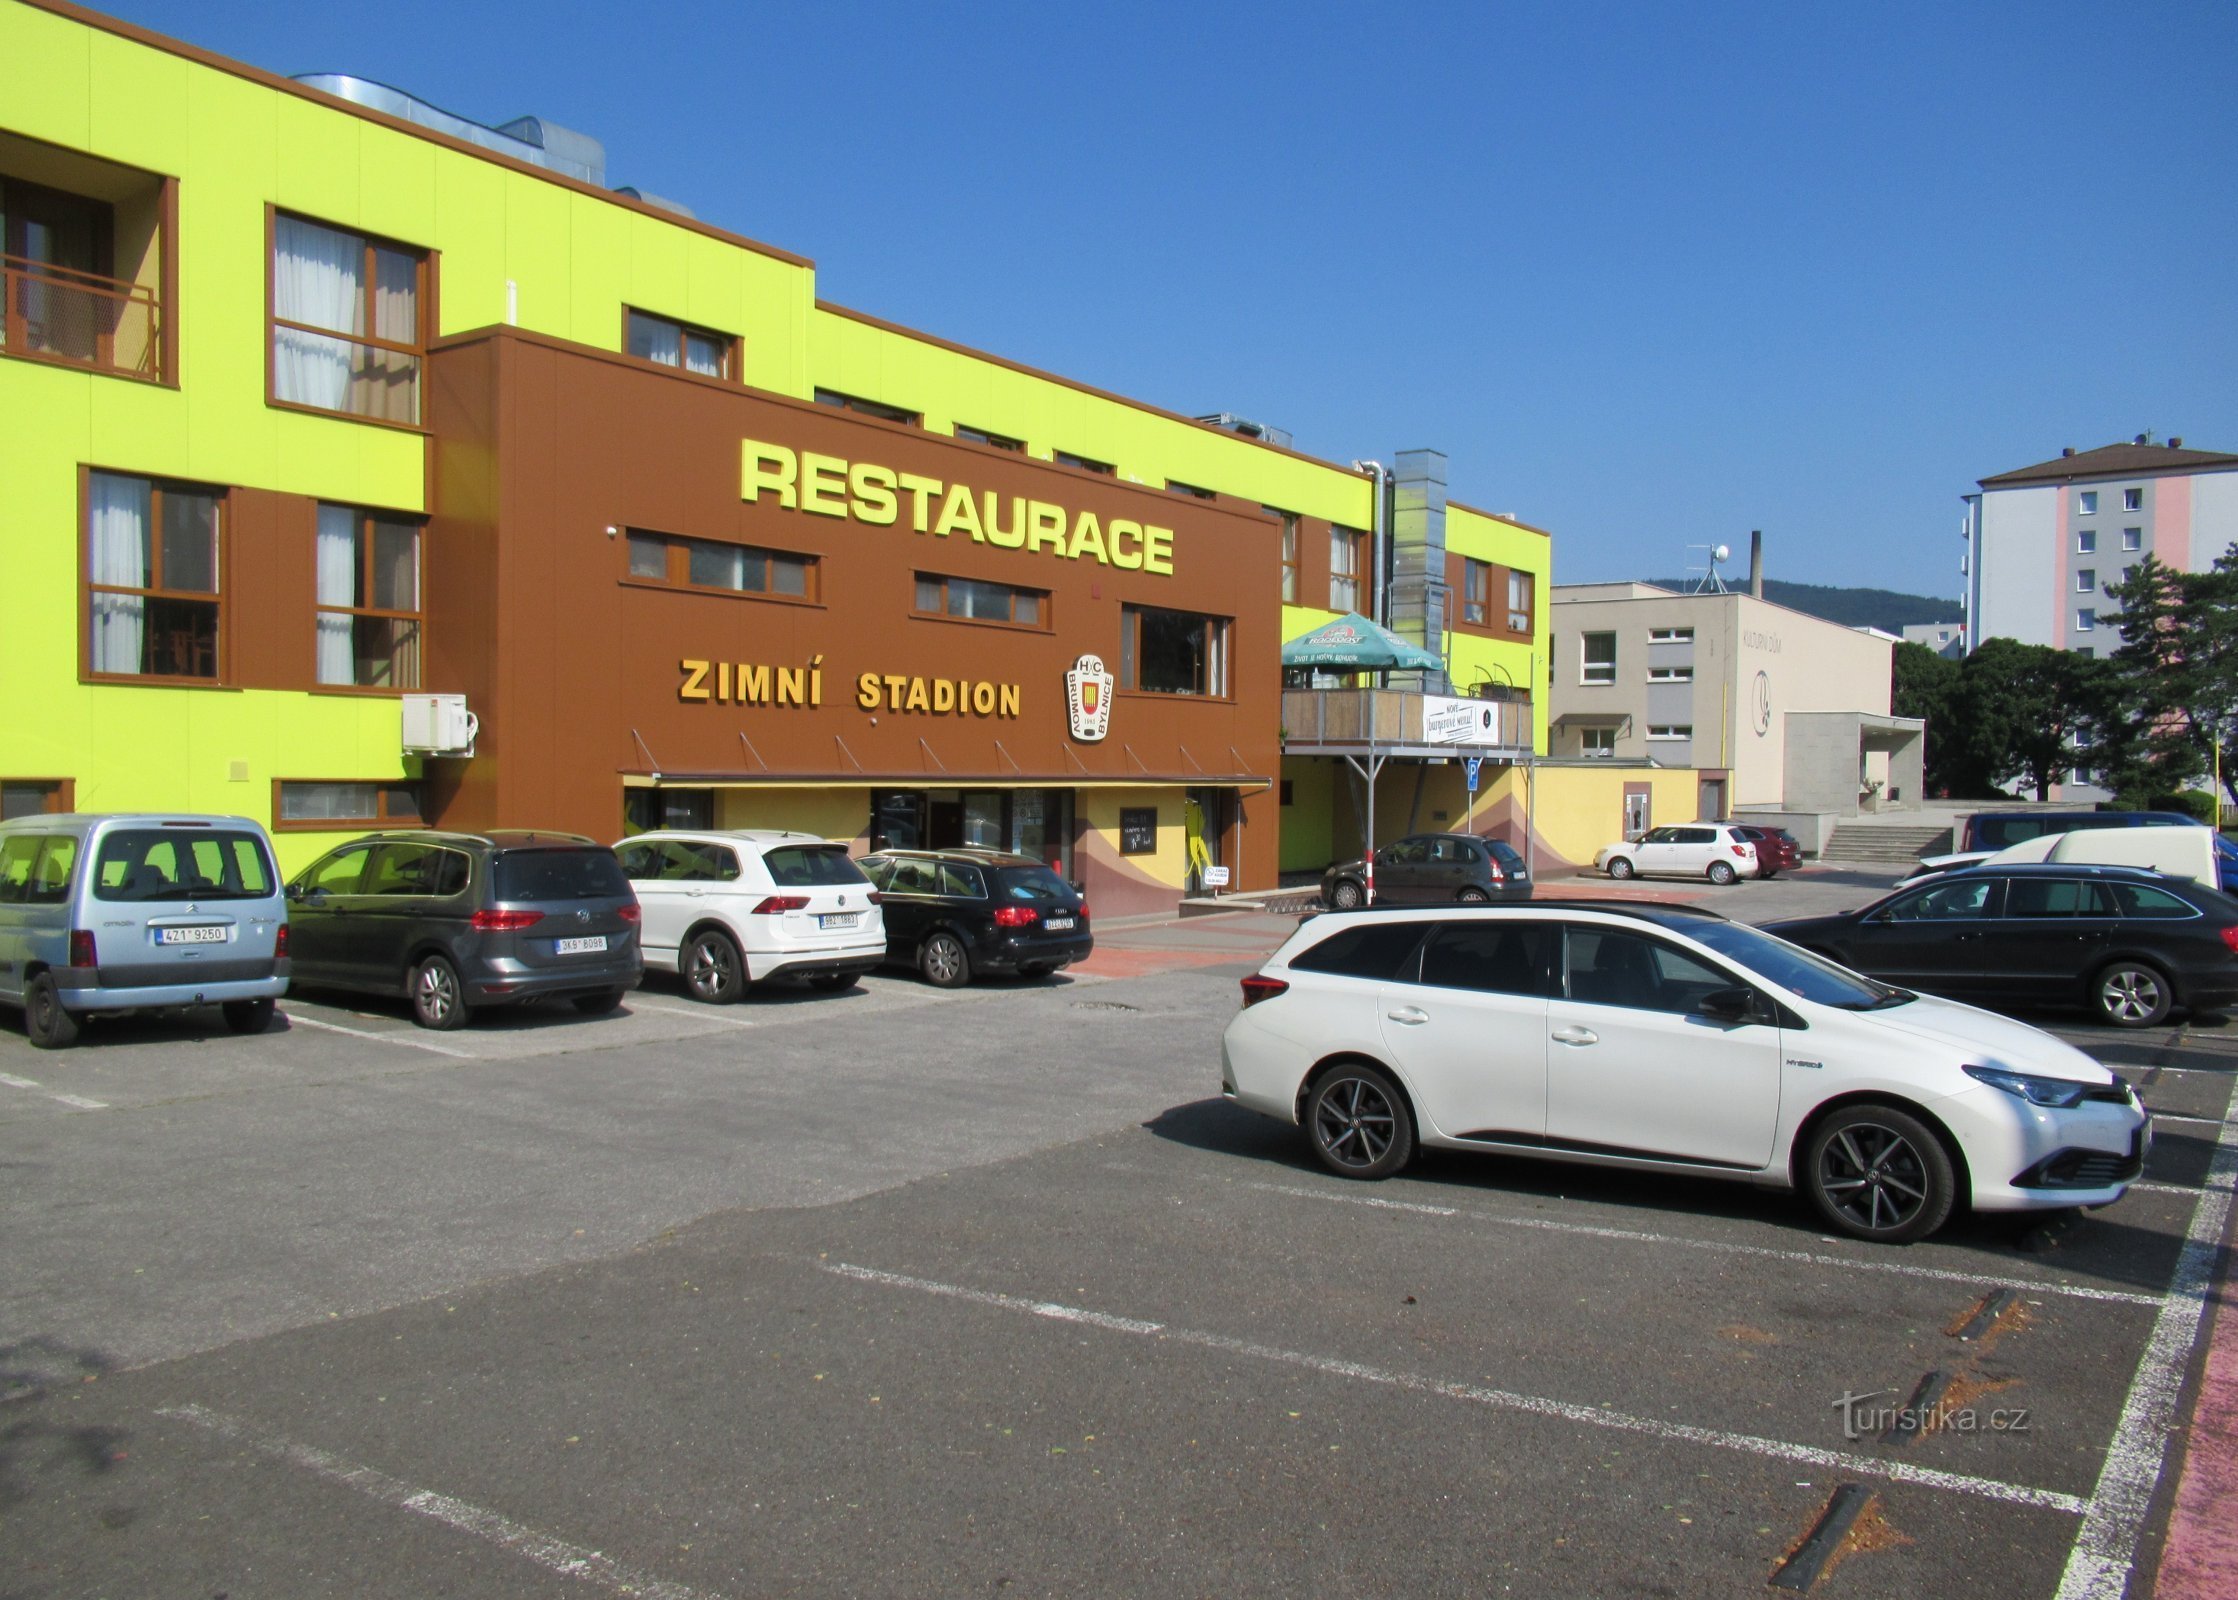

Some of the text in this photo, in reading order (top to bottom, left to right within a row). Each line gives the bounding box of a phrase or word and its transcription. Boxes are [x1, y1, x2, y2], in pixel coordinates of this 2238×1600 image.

[741, 438, 1174, 575] RESTAURACE
[680, 654, 1021, 716] ZIMNÍ STADION
[1068, 673, 1081, 733] BRUMOV
[1098, 676, 1112, 734] BYLNICE
[1470, 764, 1477, 781] P
[165, 928, 222, 942] 4Z1 9250
[562, 937, 604, 951] 3K9 8098
